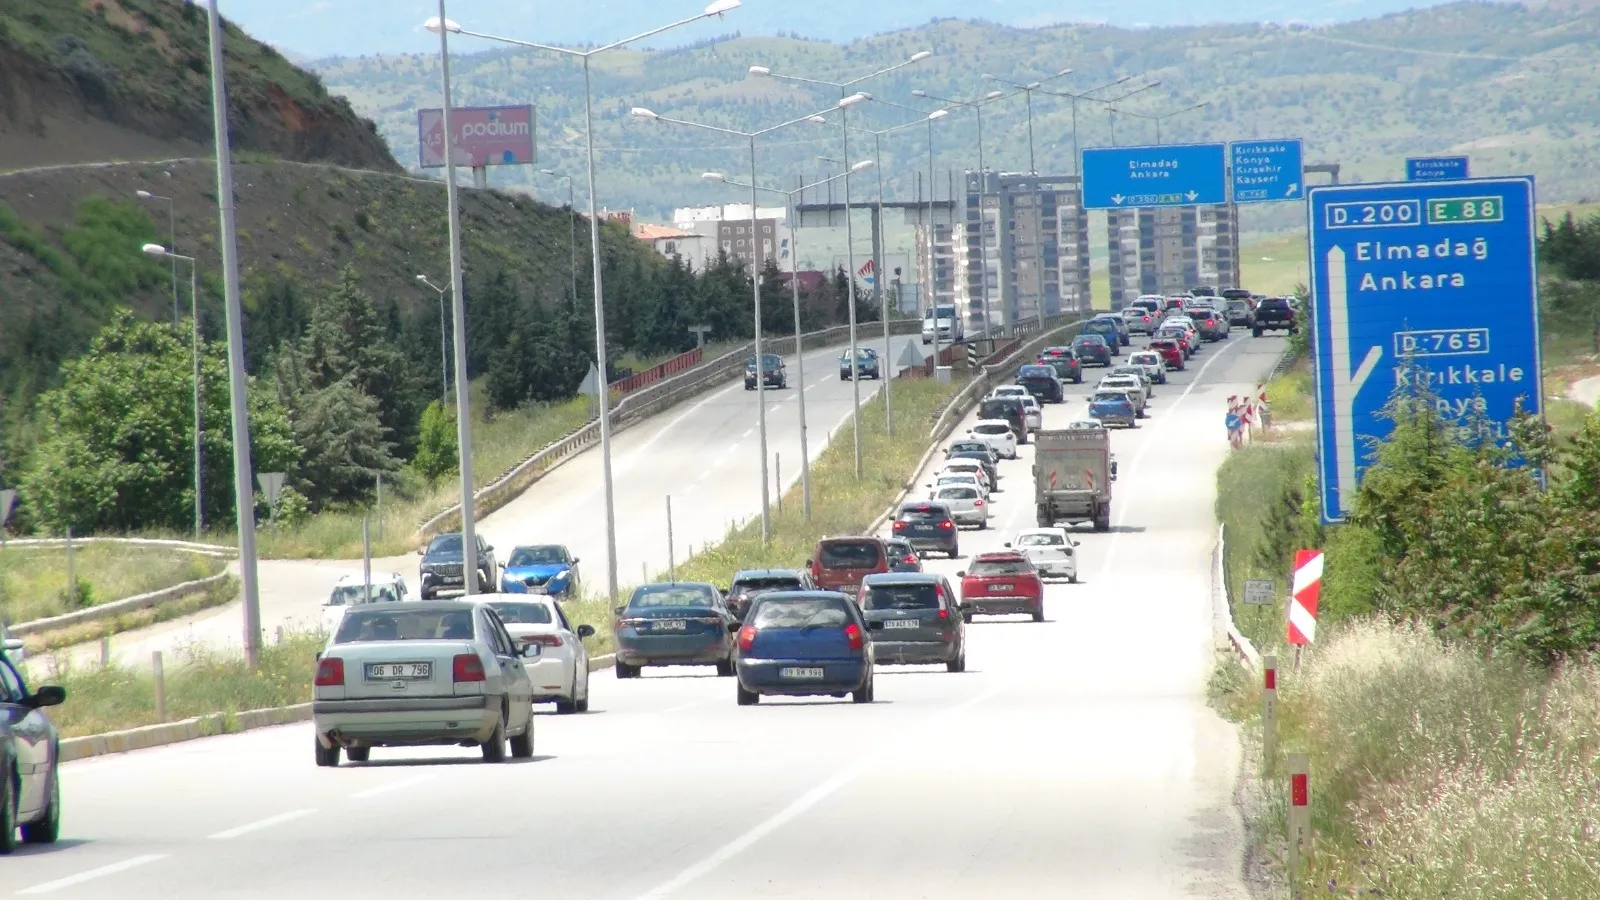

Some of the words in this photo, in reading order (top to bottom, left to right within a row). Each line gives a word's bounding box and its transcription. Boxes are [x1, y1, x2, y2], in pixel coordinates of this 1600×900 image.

[462, 118, 529, 139] podium
[1236, 145, 1286, 154] Kırıkkale
[1236, 156, 1270, 165] Konya
[1130, 170, 1170, 178] Ankara
[1236, 175, 1279, 184] Kayseri
[1334, 204, 1411, 224] D.200
[1435, 201, 1495, 220] E.88
[1356, 238, 1488, 261] Elmadağ
[1359, 271, 1465, 291] Ankara
[1402, 333, 1481, 351] D.765
[1394, 364, 1524, 386] Kırıkkale
[373, 665, 385, 676] 06
[392, 665, 404, 676] DR
[411, 664, 428, 675] 796
